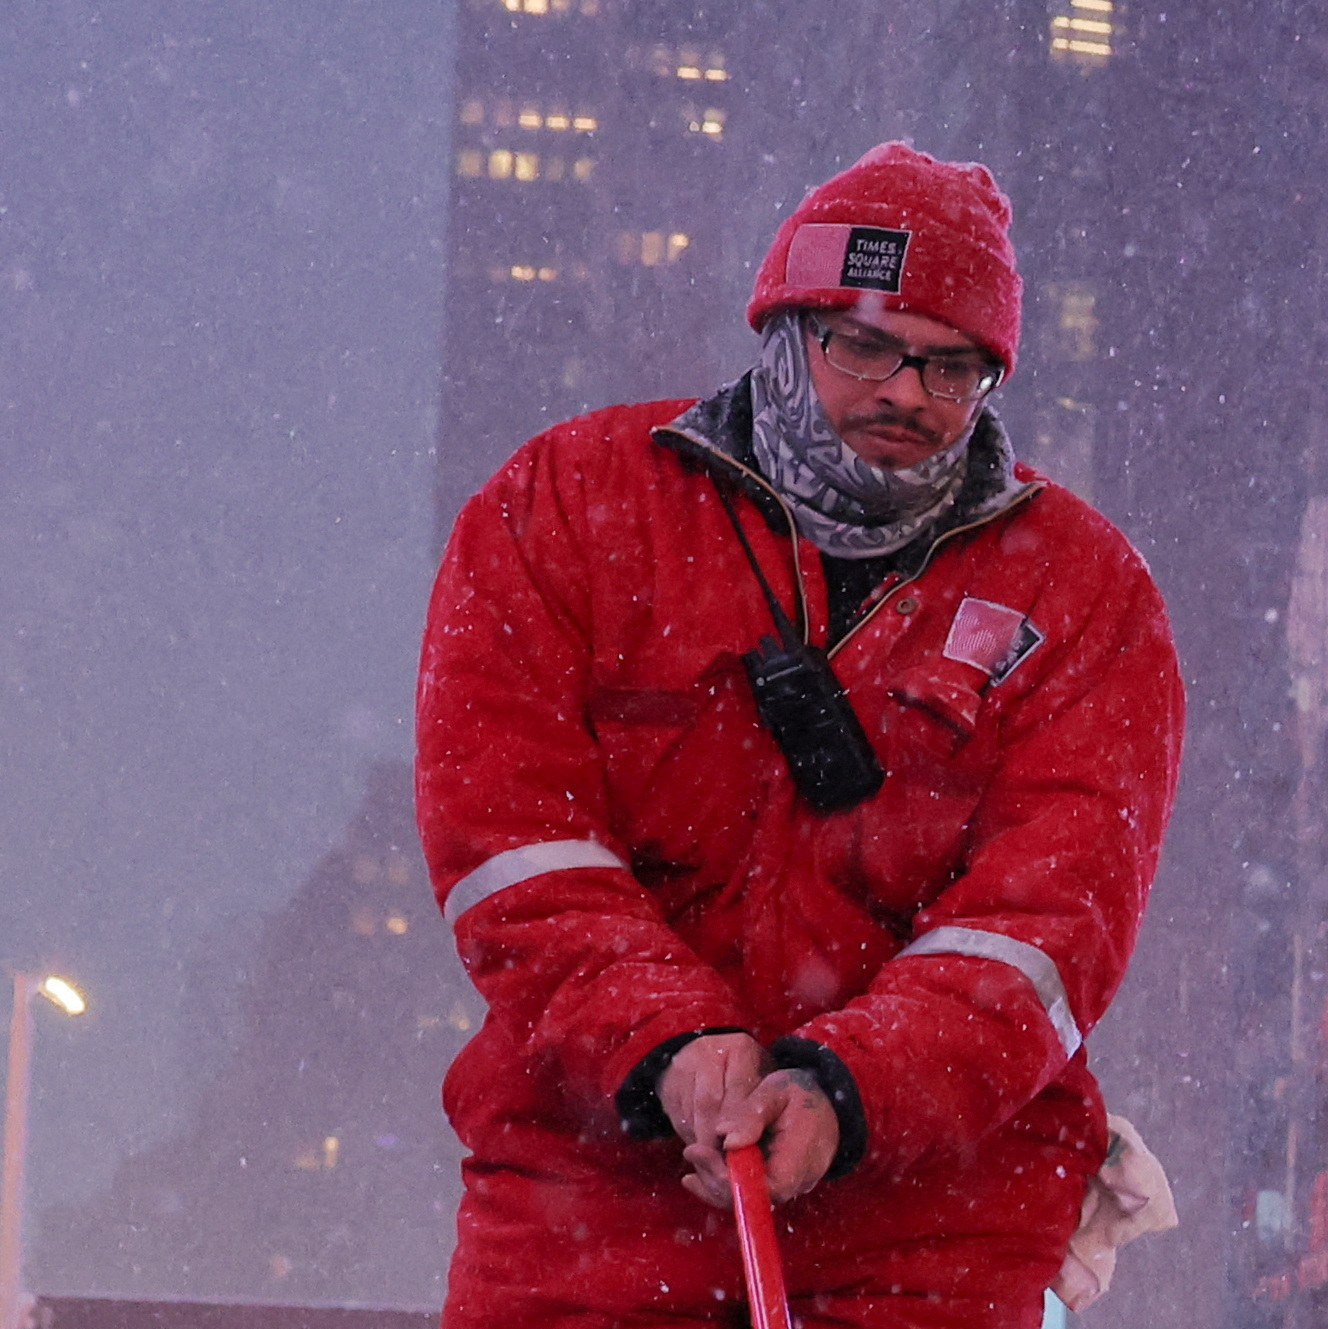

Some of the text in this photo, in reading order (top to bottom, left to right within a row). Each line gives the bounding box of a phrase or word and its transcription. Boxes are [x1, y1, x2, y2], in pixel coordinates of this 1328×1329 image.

[856, 239, 897, 255] TIMES
[847, 252, 898, 269] SQUARE
[847, 267, 892, 282] ALLIANCE
